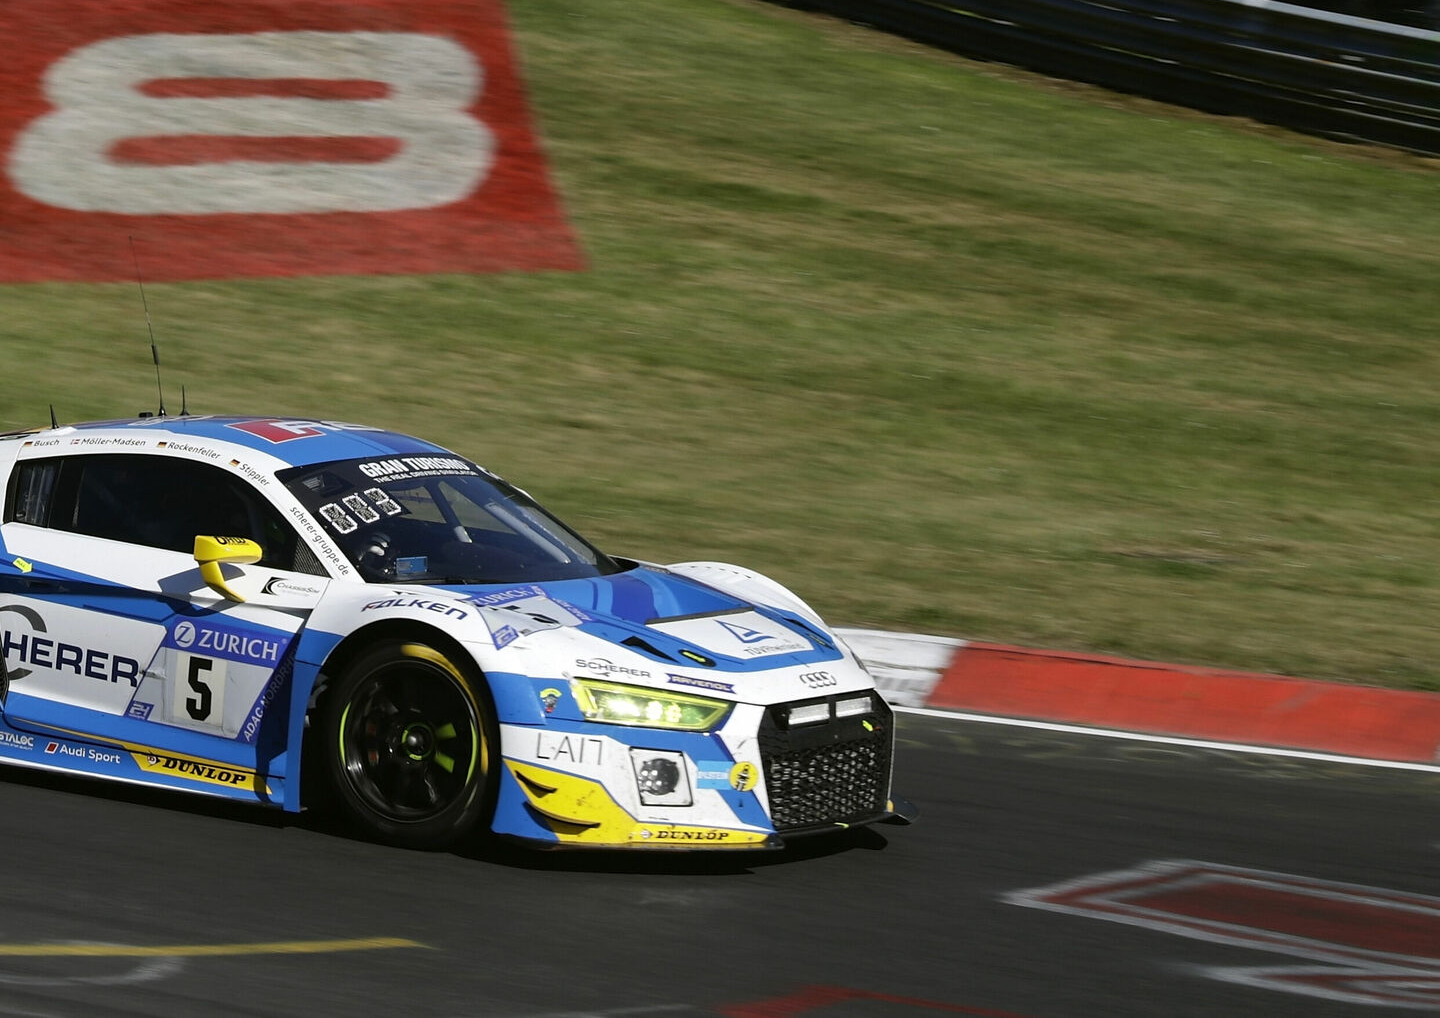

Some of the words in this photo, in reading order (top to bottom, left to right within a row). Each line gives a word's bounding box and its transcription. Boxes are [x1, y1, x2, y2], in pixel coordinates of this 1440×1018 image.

[34, 438, 60, 447] Busch
[81, 437, 146, 447] Möller-Madsen
[168, 441, 221, 460] Rockenfeller
[239, 463, 270, 487] Stippler
[358, 459, 410, 478] GRAN
[401, 457, 471, 471] TURISMO
[290, 507, 349, 576] scherer-gruppe.de
[361, 598, 469, 621] FALKEN
[197, 628, 278, 662] ZURICH
[576, 658, 651, 679] SCHERER
[186, 656, 213, 722] 5
[671, 674, 730, 691] RAVENOL
[243, 707, 264, 742] ADAC
[59, 743, 86, 758] Audi
[88, 749, 121, 765] Sport
[162, 758, 246, 785] DUNLOP
[655, 830, 729, 841] DUNLOP
